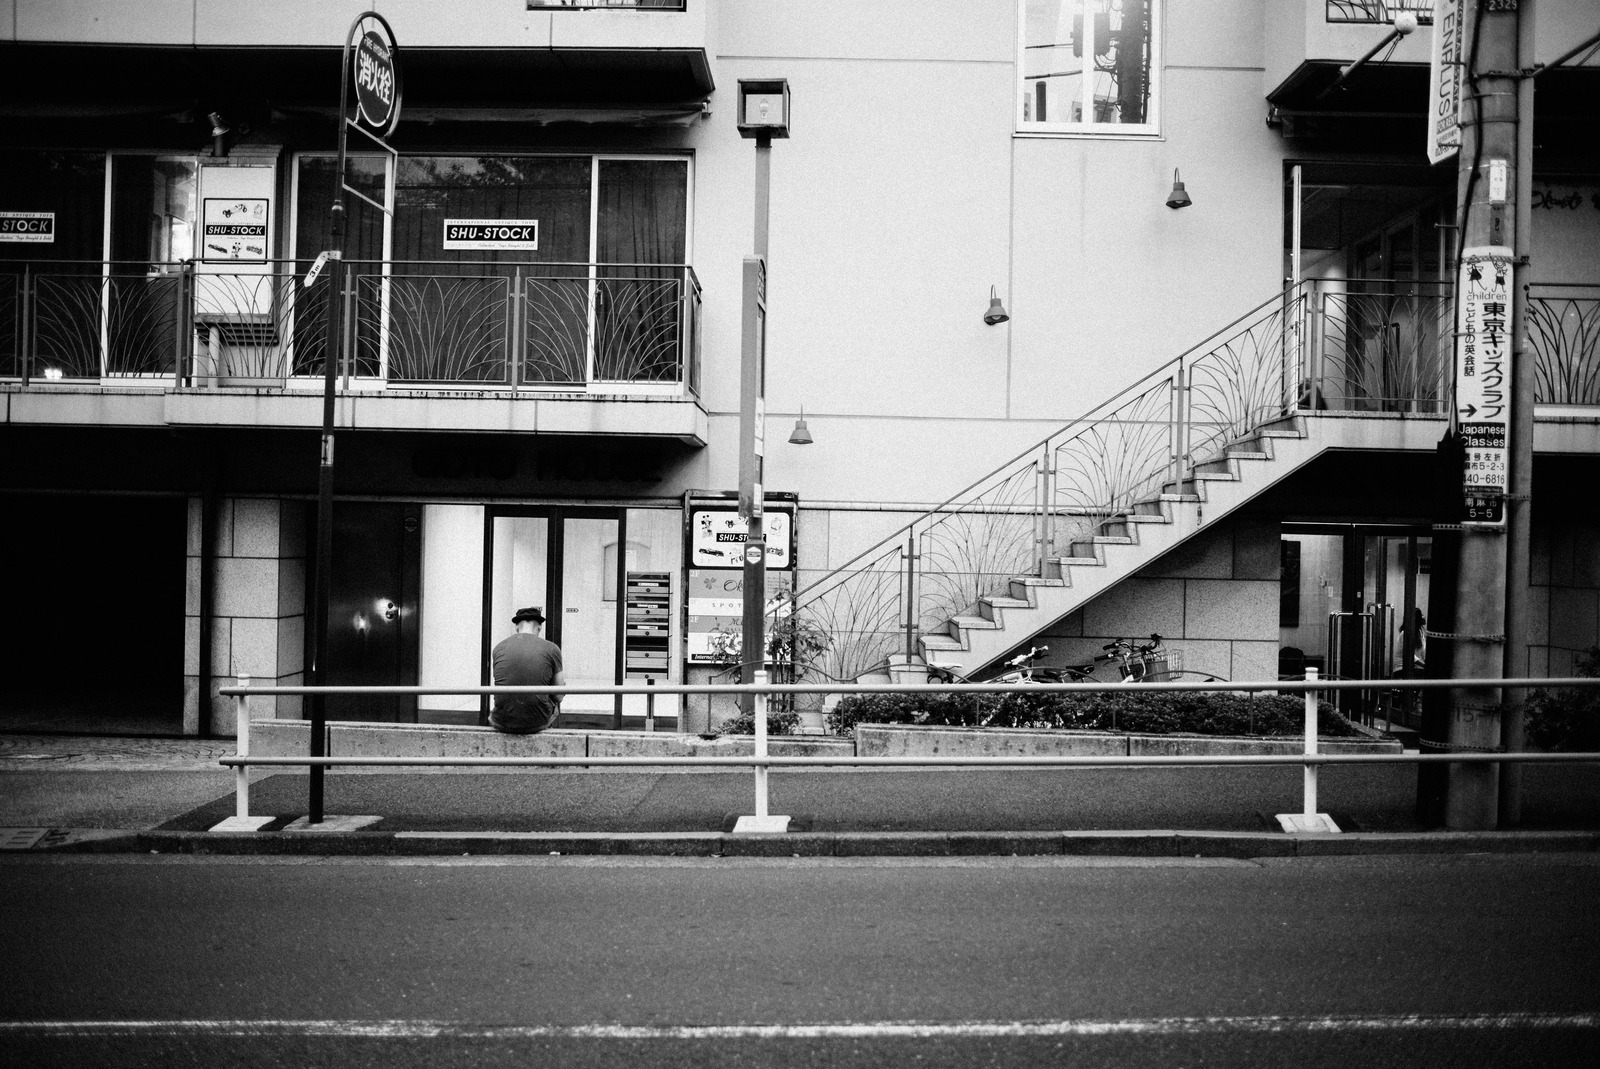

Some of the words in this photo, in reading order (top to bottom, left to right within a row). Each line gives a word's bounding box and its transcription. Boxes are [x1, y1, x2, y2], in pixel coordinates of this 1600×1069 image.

[1437, 12, 1455, 117] ENPLUS
[358, 49, 392, 105] 消火栓
[2, 220, 48, 232] STOCK
[208, 226, 263, 235] SHU-STOCK
[450, 227, 531, 239] SHU-STOCK
[1466, 292, 1507, 302] children
[1463, 302, 1476, 377] こどもの英会話
[1481, 302, 1506, 419] 東京キッズクラブ
[1459, 424, 1505, 435] Japanese
[1461, 436, 1504, 447] Classes
[1469, 508, 1493, 518] 5-5
